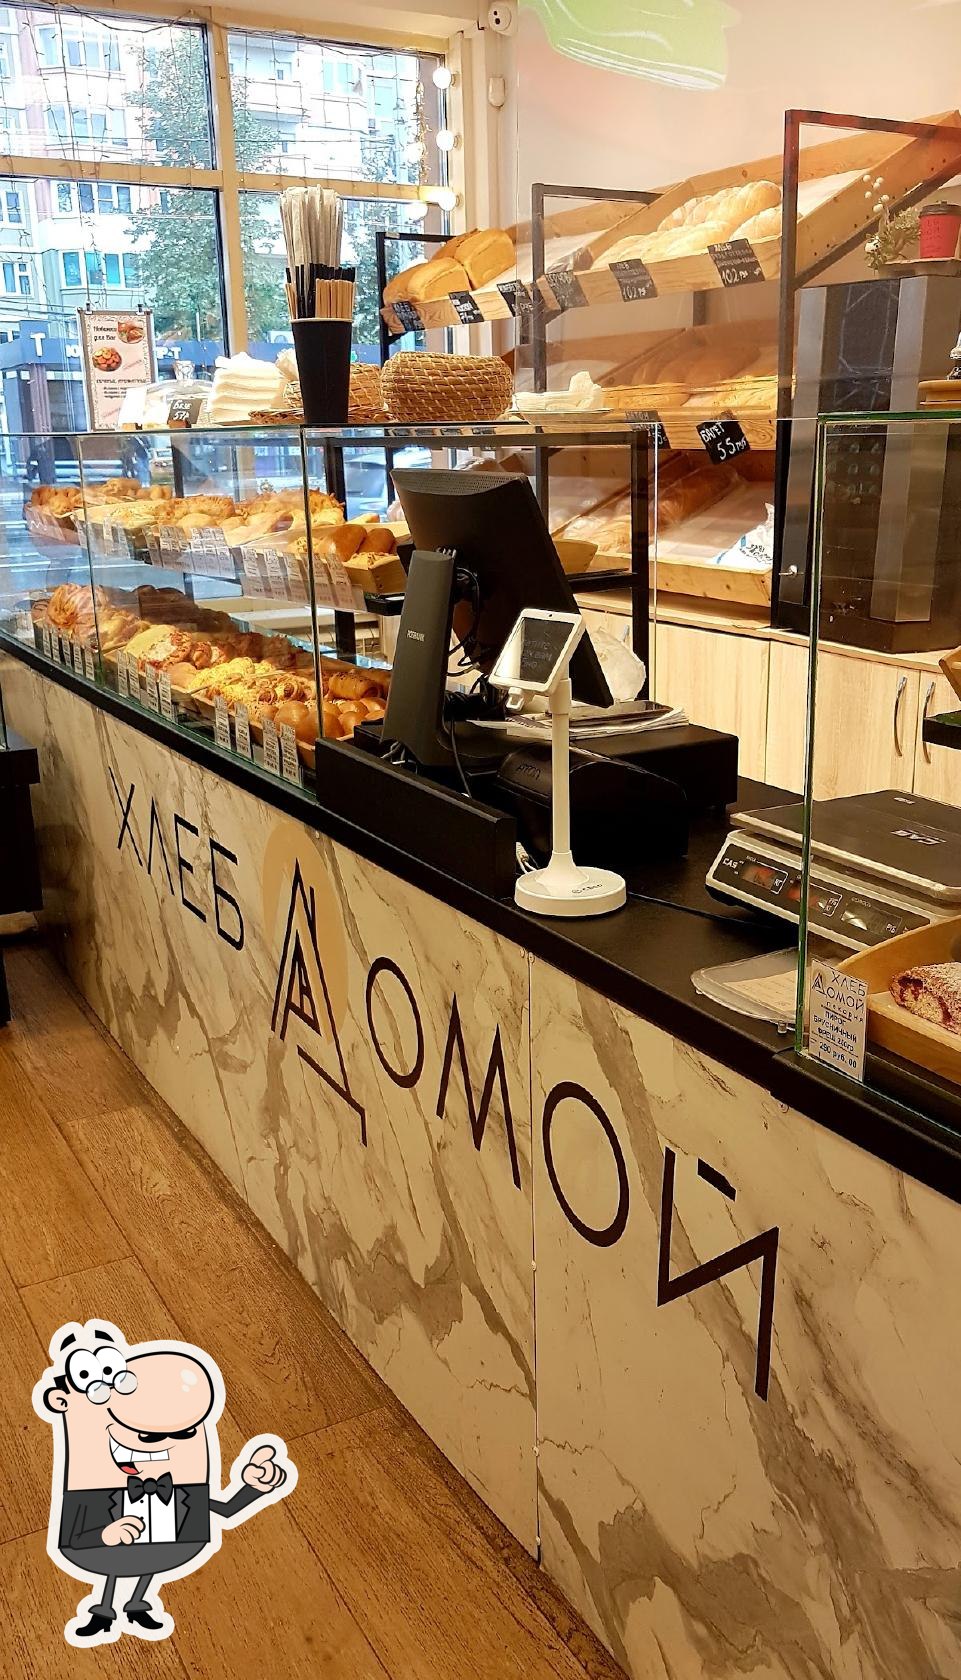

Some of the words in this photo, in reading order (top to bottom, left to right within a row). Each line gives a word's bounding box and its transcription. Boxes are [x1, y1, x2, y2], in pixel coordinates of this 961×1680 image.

[700, 421, 725, 443] БАГЕТ
[109, 767, 244, 951] ХЛЕБ
[722, 858, 739, 870] CAS
[811, 972, 864, 1014] ДОМОЙ
[831, 970, 867, 997] ХЛЕБ
[813, 1014, 857, 1043] БРУСНИЧНЫЙ
[825, 1010, 847, 1026] ПИРОГ
[271, 857, 780, 1402] ДОМОЙ
